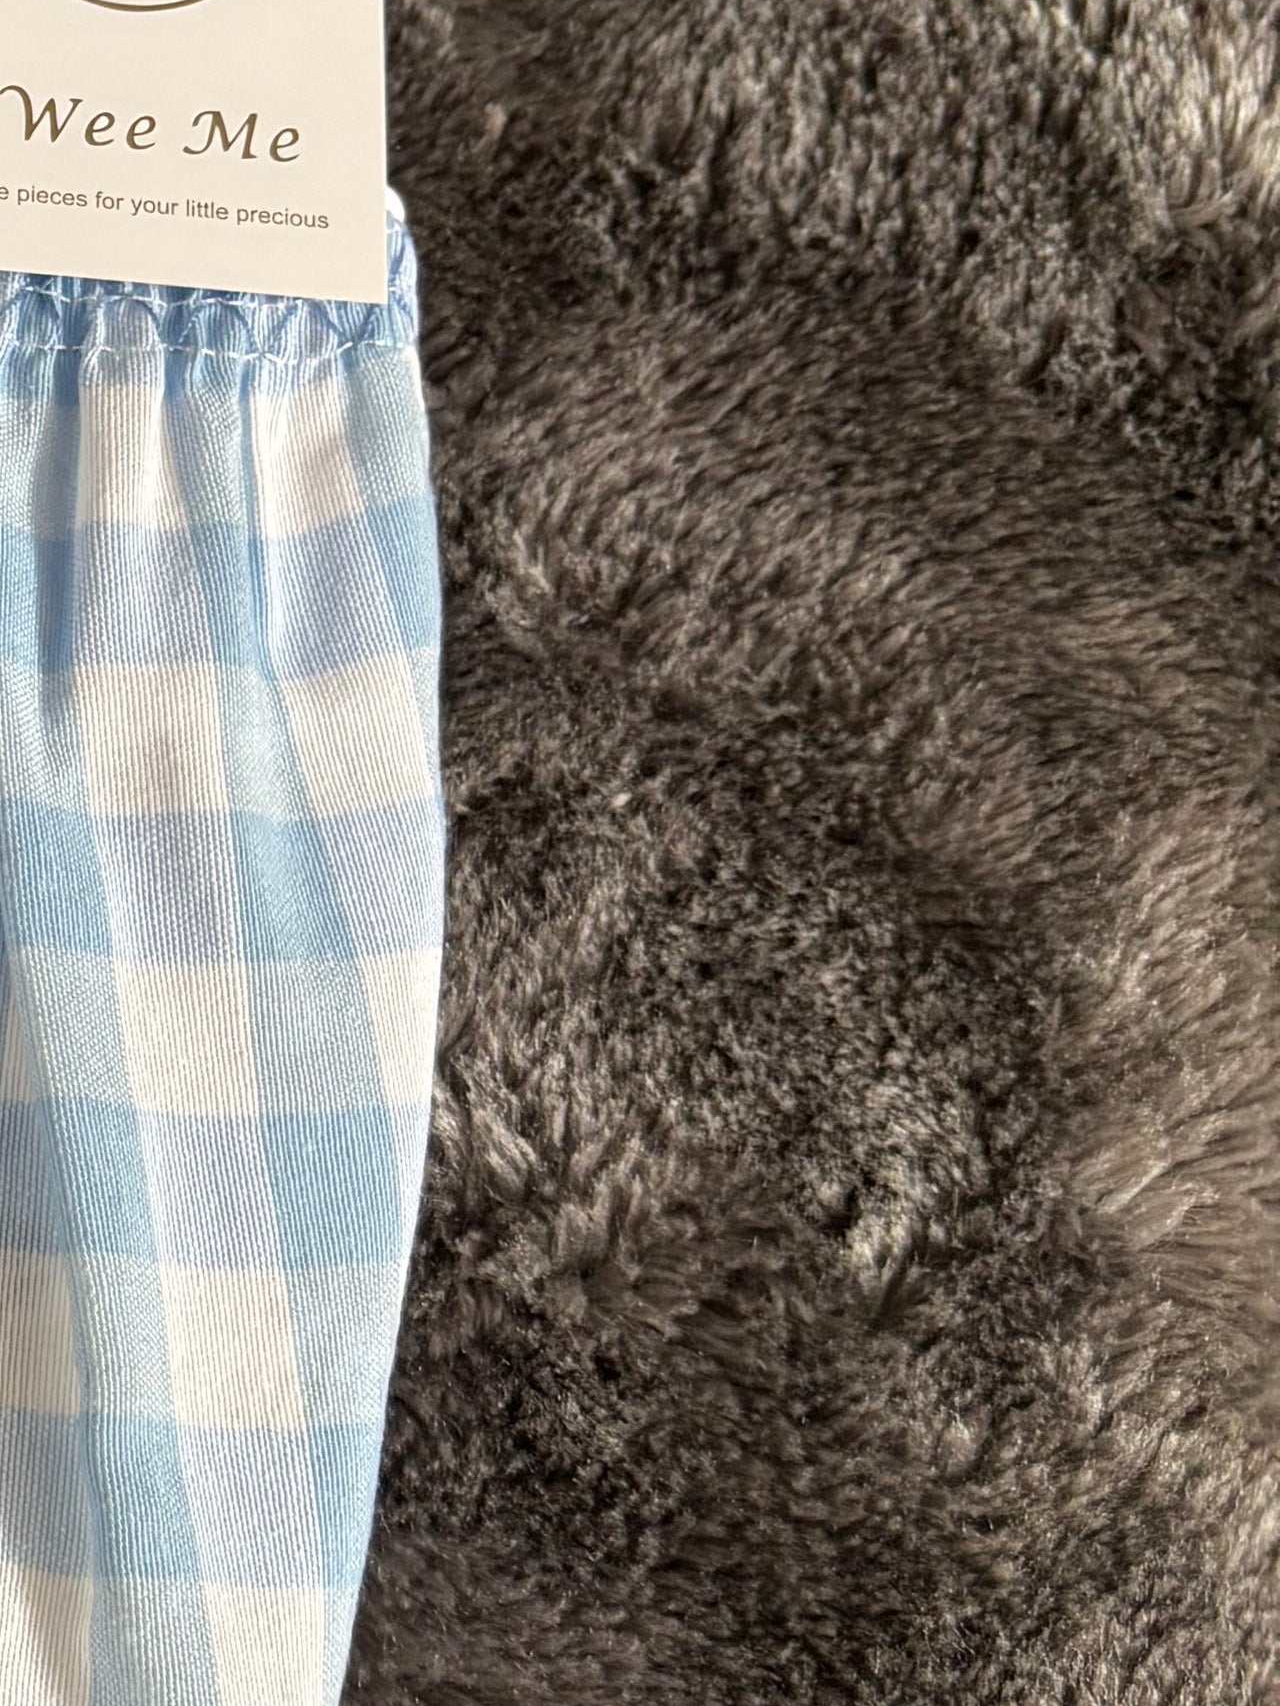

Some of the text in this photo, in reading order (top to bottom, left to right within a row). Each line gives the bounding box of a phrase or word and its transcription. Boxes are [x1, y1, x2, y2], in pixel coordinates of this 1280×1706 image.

[182, 110, 301, 163] Me
[17, 185, 89, 208] pieces
[95, 191, 125, 211] for
[130, 197, 179, 217] your
[185, 199, 229, 221] little
[236, 206, 330, 230] precious
